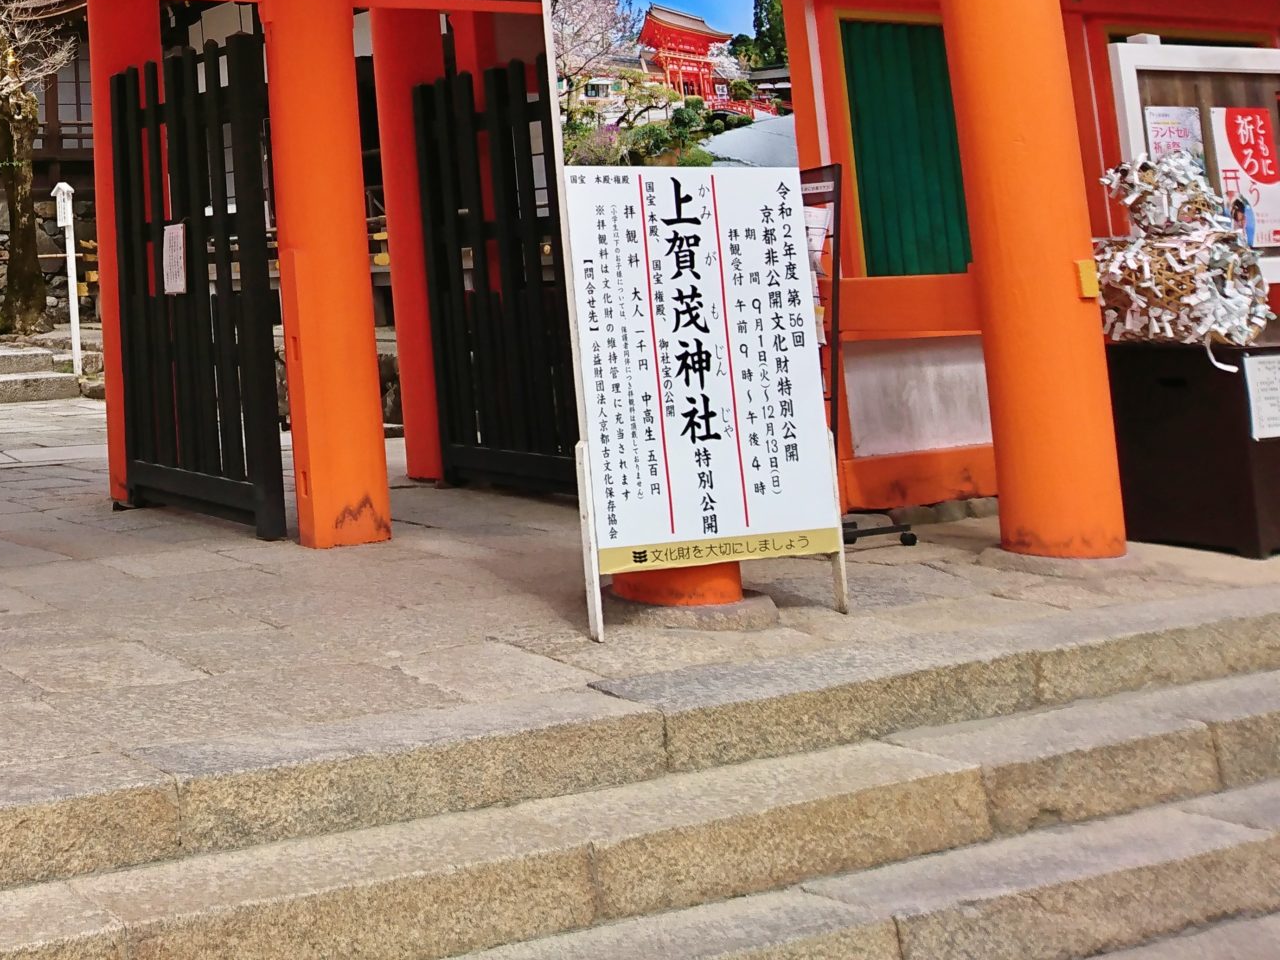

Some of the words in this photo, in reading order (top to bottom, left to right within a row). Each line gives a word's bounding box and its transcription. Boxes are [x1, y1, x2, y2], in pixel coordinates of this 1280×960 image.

[1152, 127, 1189, 138] ランドセル
[1236, 115, 1260, 206] 祈ろう
[1256, 115, 1275, 176] ともに
[624, 205, 640, 268] 拝観料
[728, 228, 744, 286] 拝観受付
[776, 181, 799, 281] 令和2年度
[661, 176, 722, 444] 上賀茂神社
[760, 205, 799, 462] 京都非公開文化財特別公開
[787, 288, 805, 347] 第56回
[695, 447, 719, 534] 特別公開
[651, 536, 810, 563] 文化財を大切にしましょう
